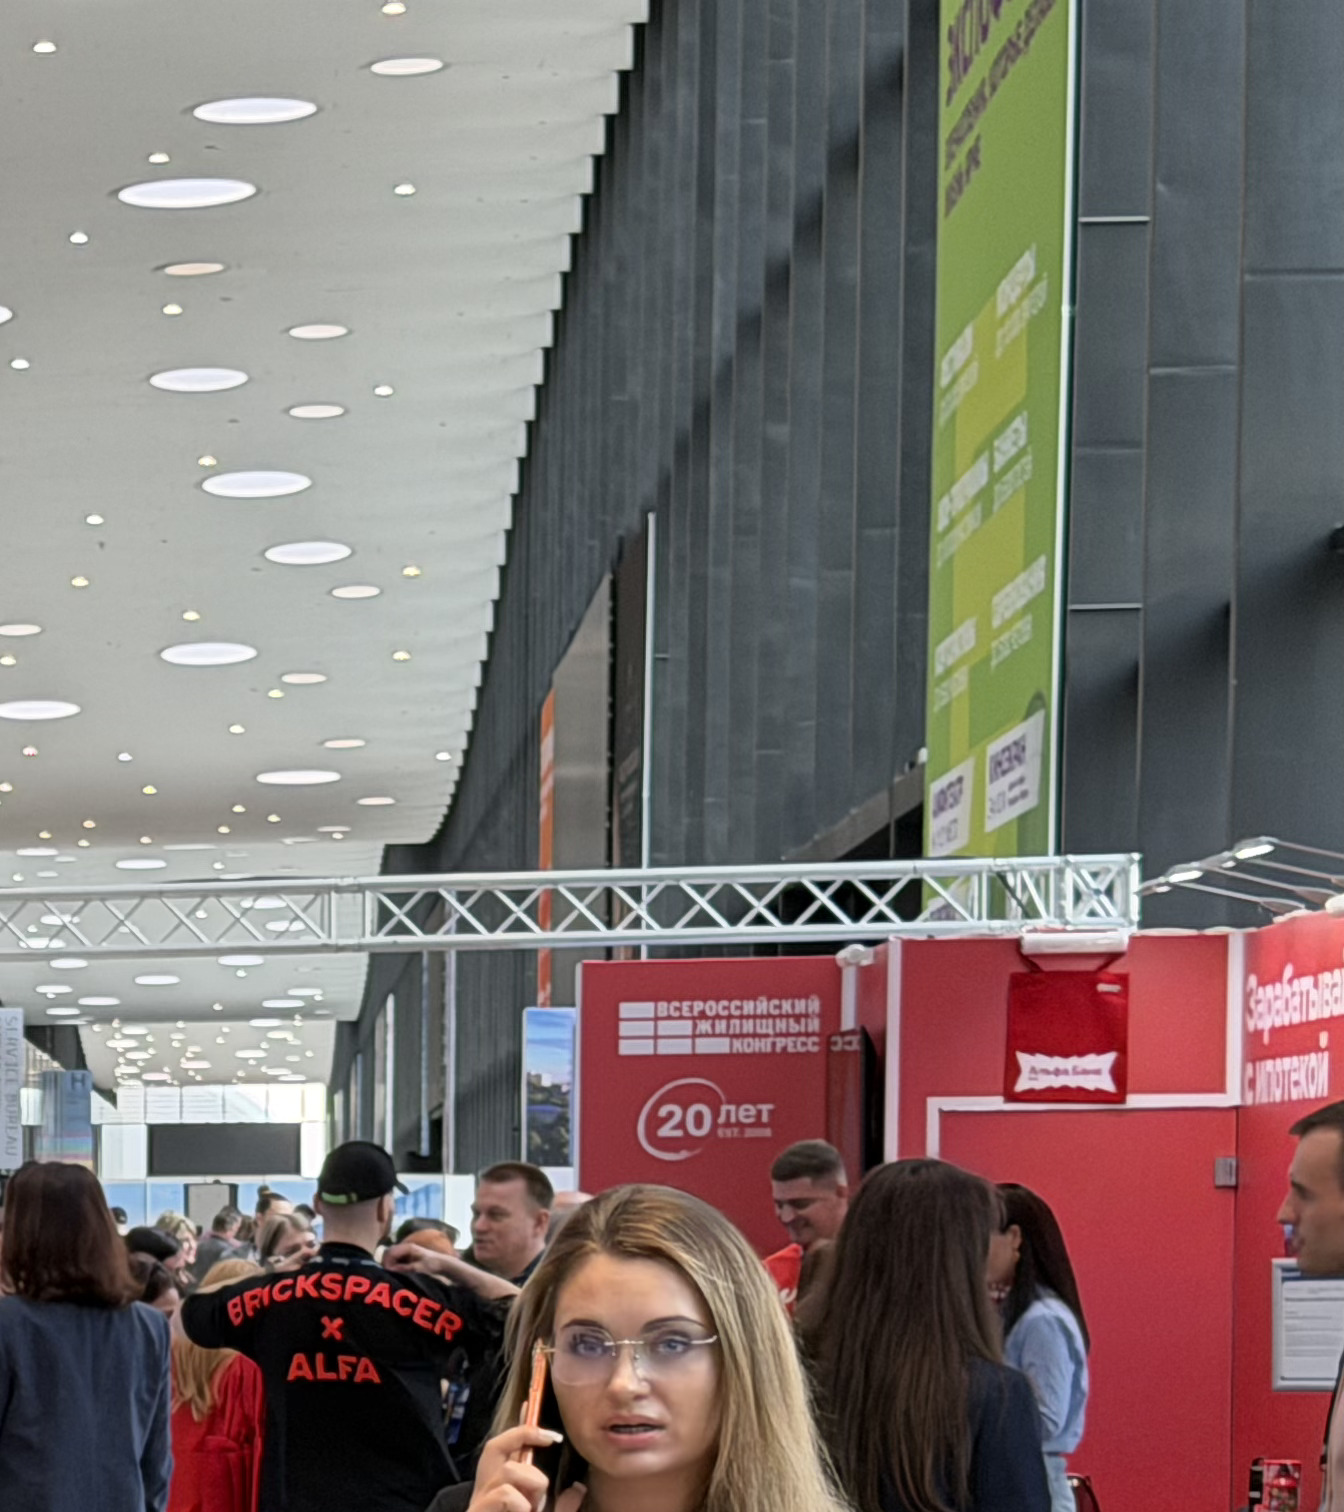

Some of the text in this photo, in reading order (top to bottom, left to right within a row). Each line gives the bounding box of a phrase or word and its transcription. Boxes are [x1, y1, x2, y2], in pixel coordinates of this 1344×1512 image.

[657, 995, 821, 1018] ВСЕРОССИЙСКИЙ
[1246, 963, 1344, 1046] Зарабатыва
[695, 1016, 821, 1036] ЖИЛИЩНЫЙ
[732, 1036, 820, 1053] КОНГРЕСС
[1256, 1030, 1330, 1105] ипотекой
[657, 1102, 775, 1138] 20 лет
[227, 1271, 463, 1341] BRICKSPACER
[287, 1353, 380, 1383] ALFA
